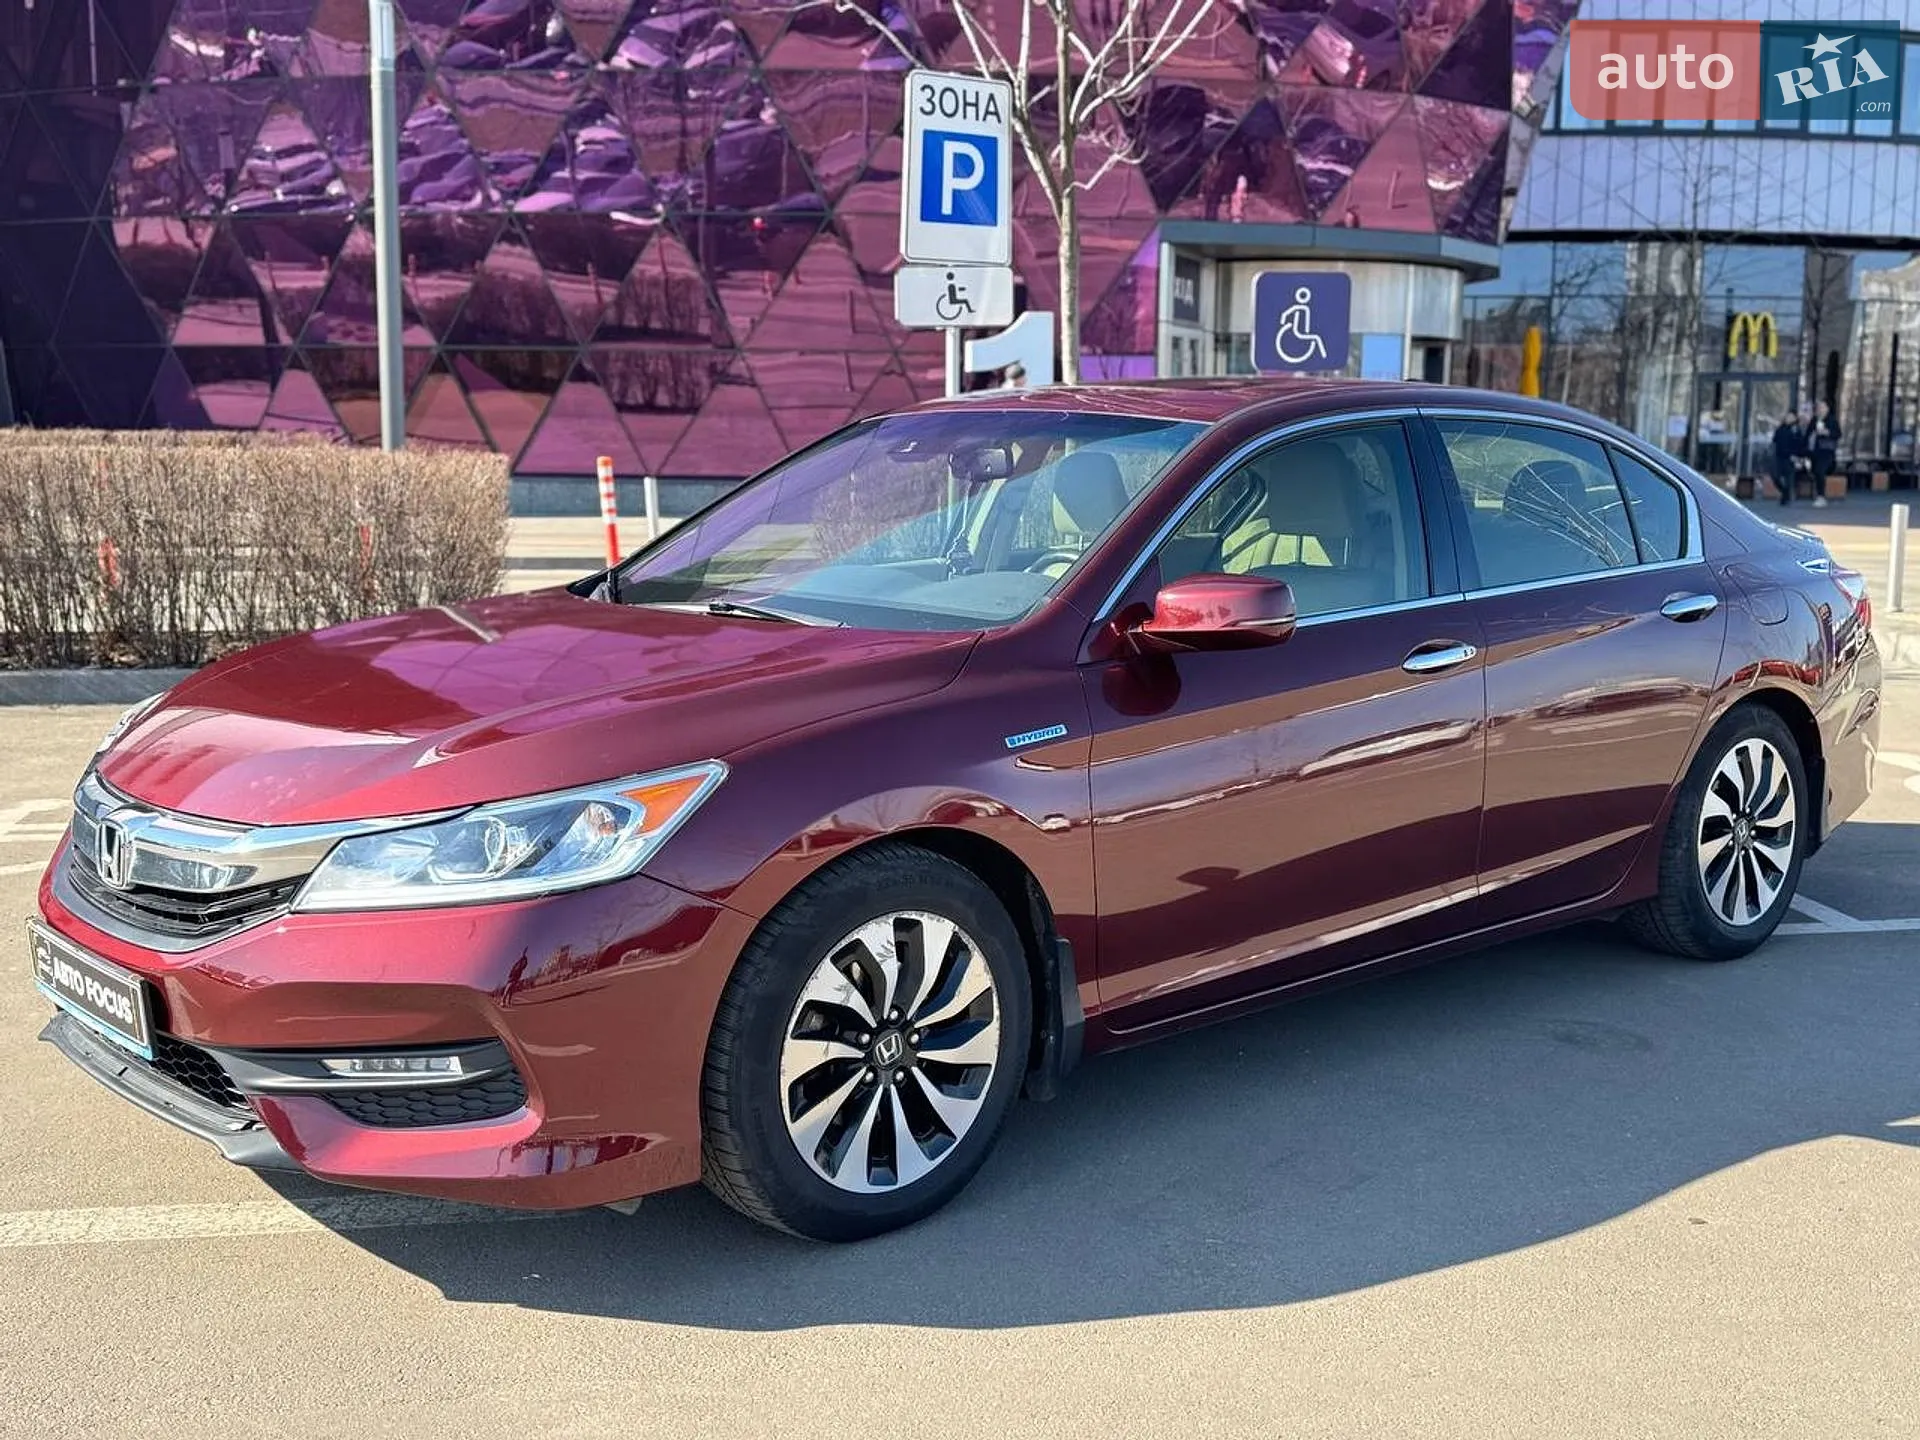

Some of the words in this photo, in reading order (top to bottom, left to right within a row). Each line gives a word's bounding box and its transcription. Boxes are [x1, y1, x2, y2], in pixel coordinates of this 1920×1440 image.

[919, 84, 1002, 124] ЗОНА
[941, 140, 985, 216] P
[1016, 726, 1064, 744] HYBRID
[85, 976, 133, 1024] FOCUS
